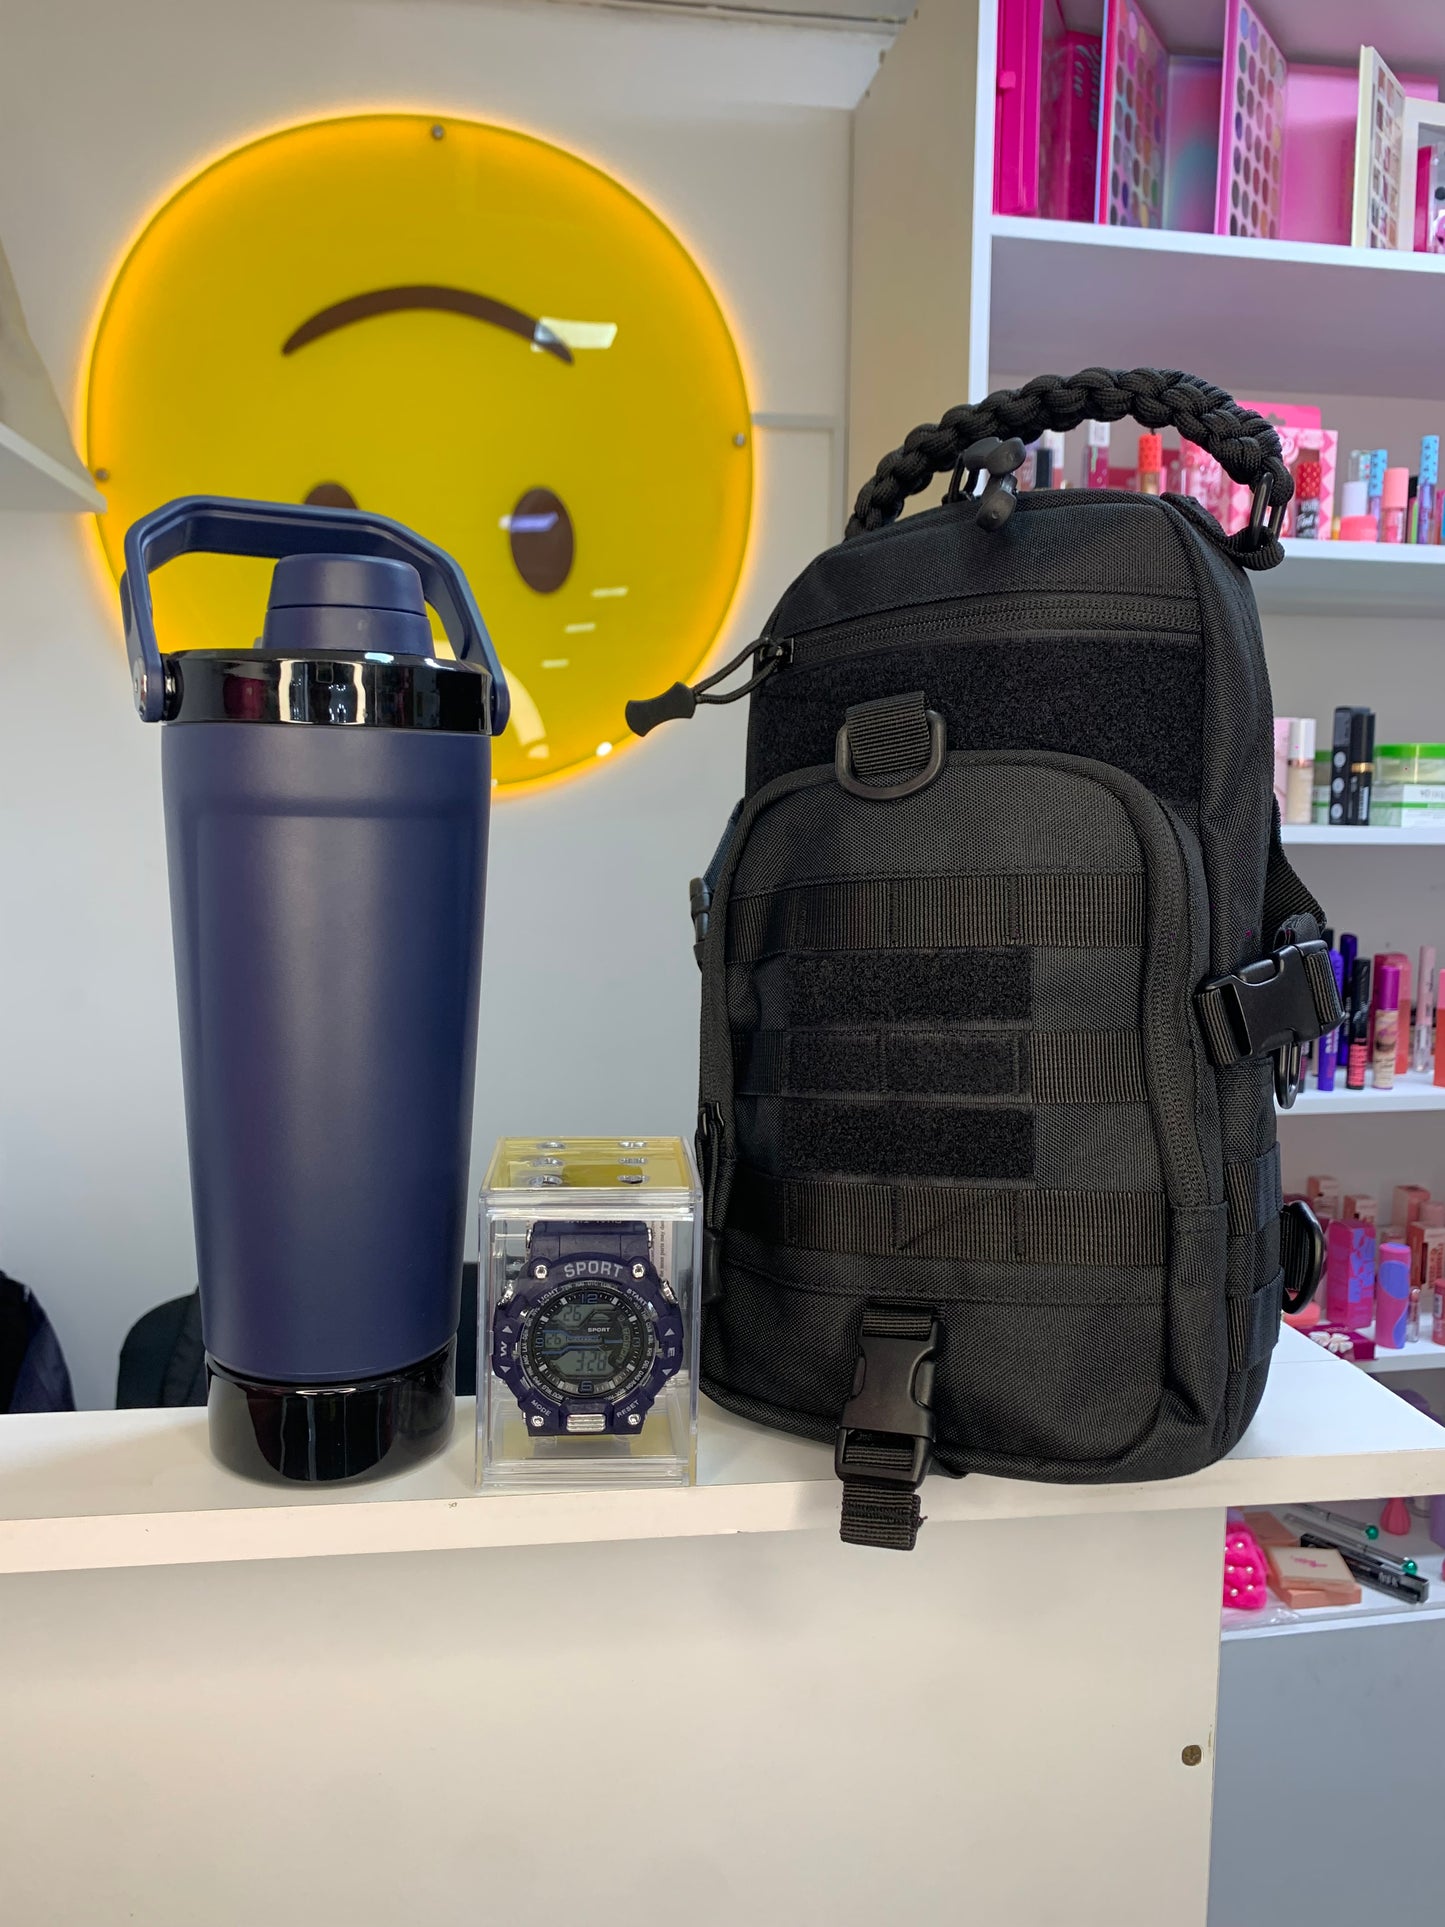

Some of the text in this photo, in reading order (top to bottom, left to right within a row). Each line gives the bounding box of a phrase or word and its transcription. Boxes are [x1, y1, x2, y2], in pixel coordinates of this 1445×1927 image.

[564, 1261, 624, 1278] SPORT
[537, 1288, 558, 1304] LIGHT
[581, 1293, 598, 1304] 12
[626, 1288, 648, 1308] START
[501, 1341, 509, 1357] W
[580, 1381, 593, 1392] 6
[531, 1399, 552, 1416] MODE
[616, 1400, 640, 1418] RESET
